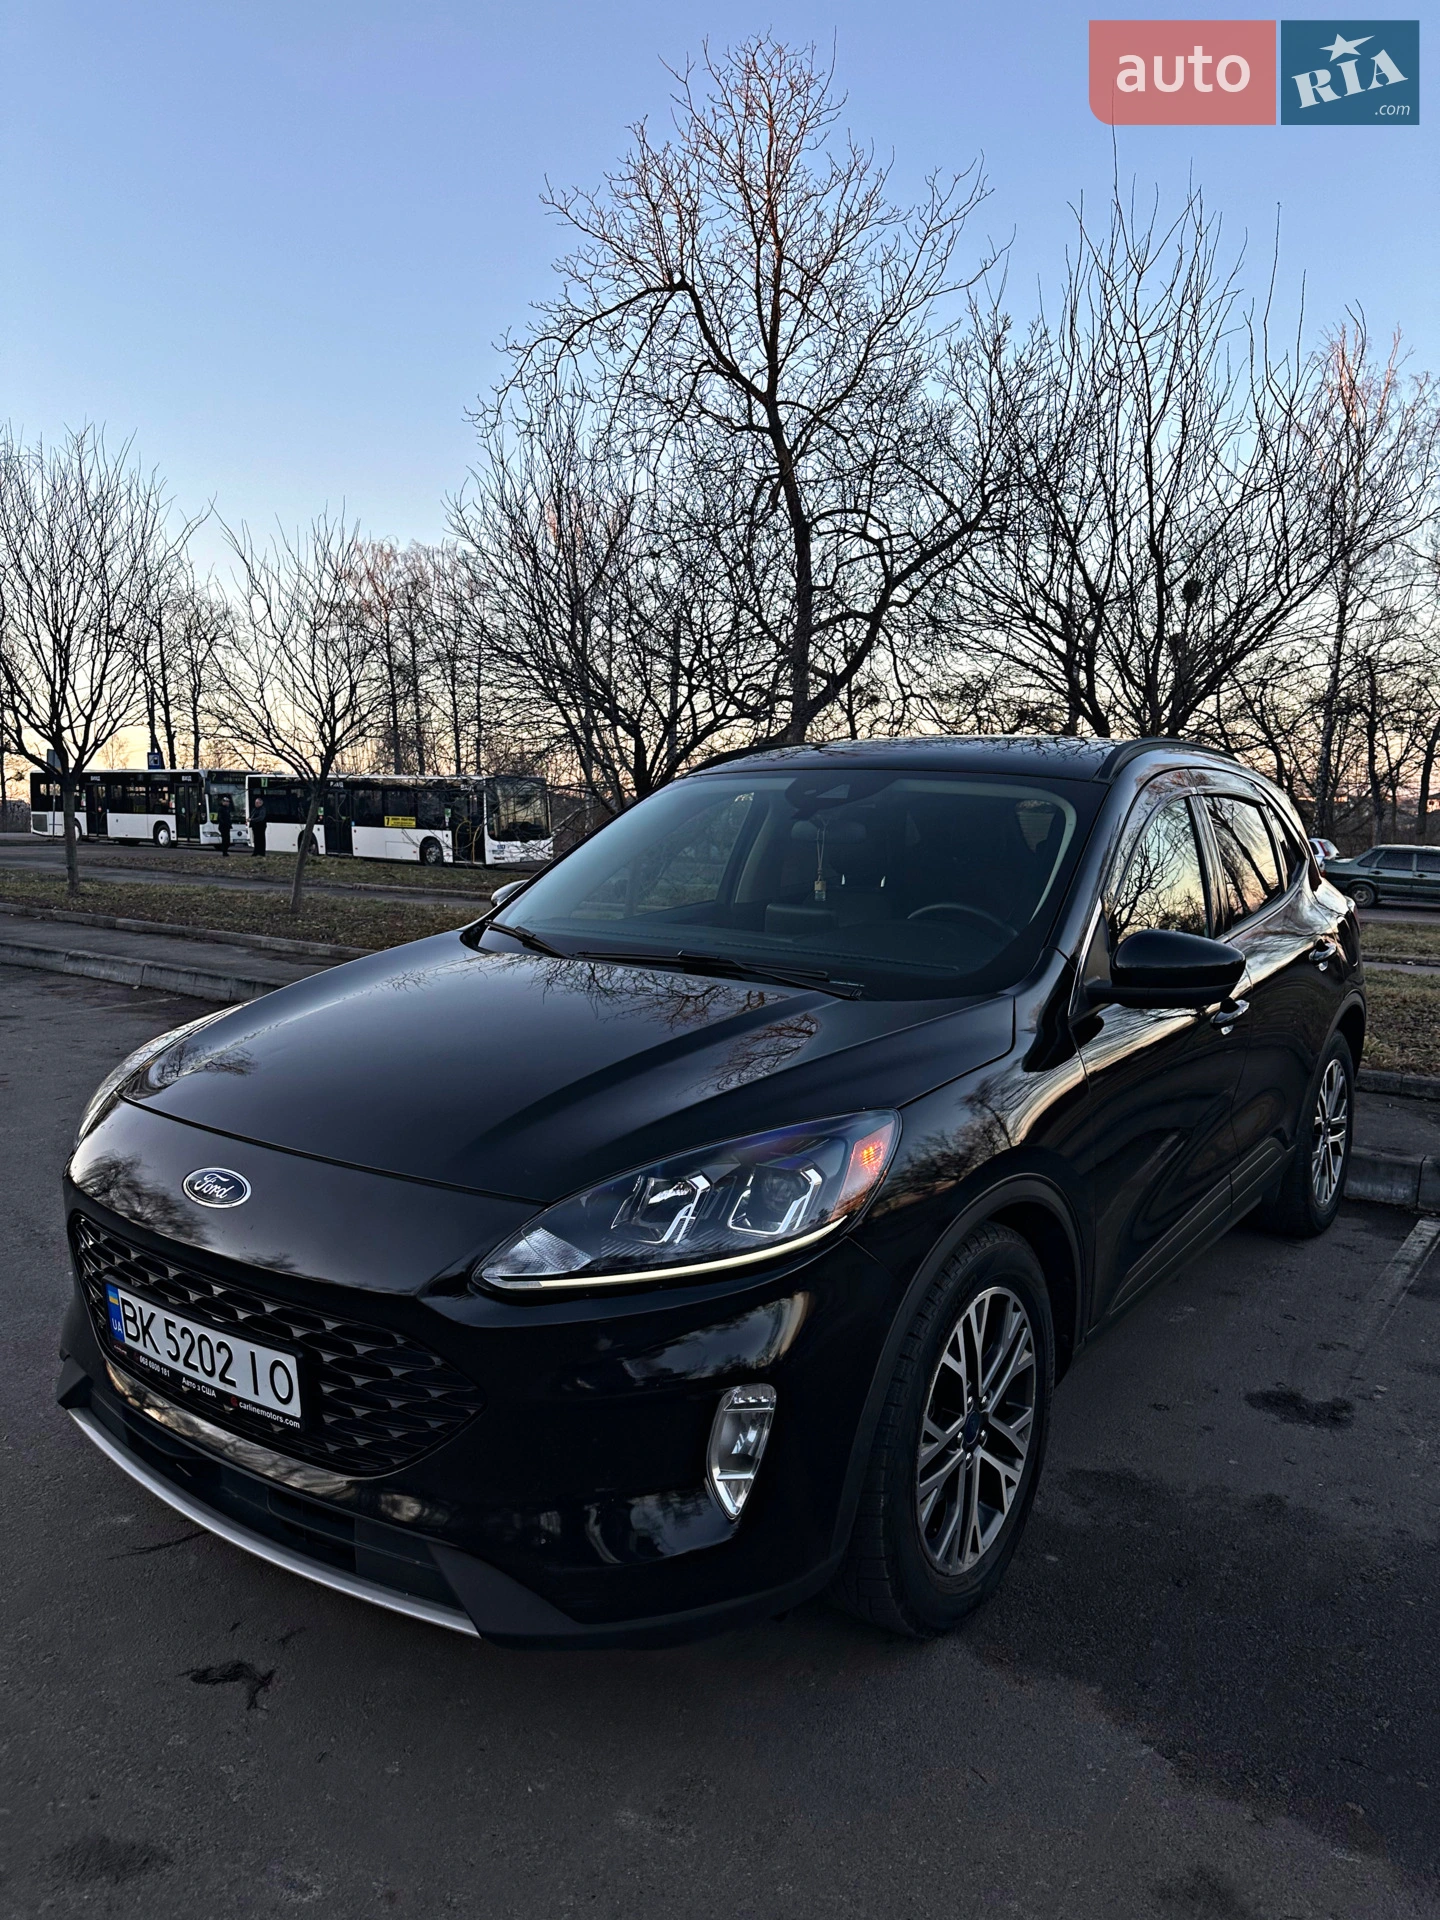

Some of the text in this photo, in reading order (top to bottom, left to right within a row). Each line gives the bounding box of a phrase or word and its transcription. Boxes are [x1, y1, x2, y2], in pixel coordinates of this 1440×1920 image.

[193, 1173, 235, 1198] Ford
[112, 1317, 123, 1334] UA
[121, 1297, 161, 1355] BK
[164, 1317, 237, 1388] 5202
[181, 1377, 197, 1389] Авто
[201, 1385, 217, 1398] США
[239, 1401, 301, 1429] carlinemotors.com
